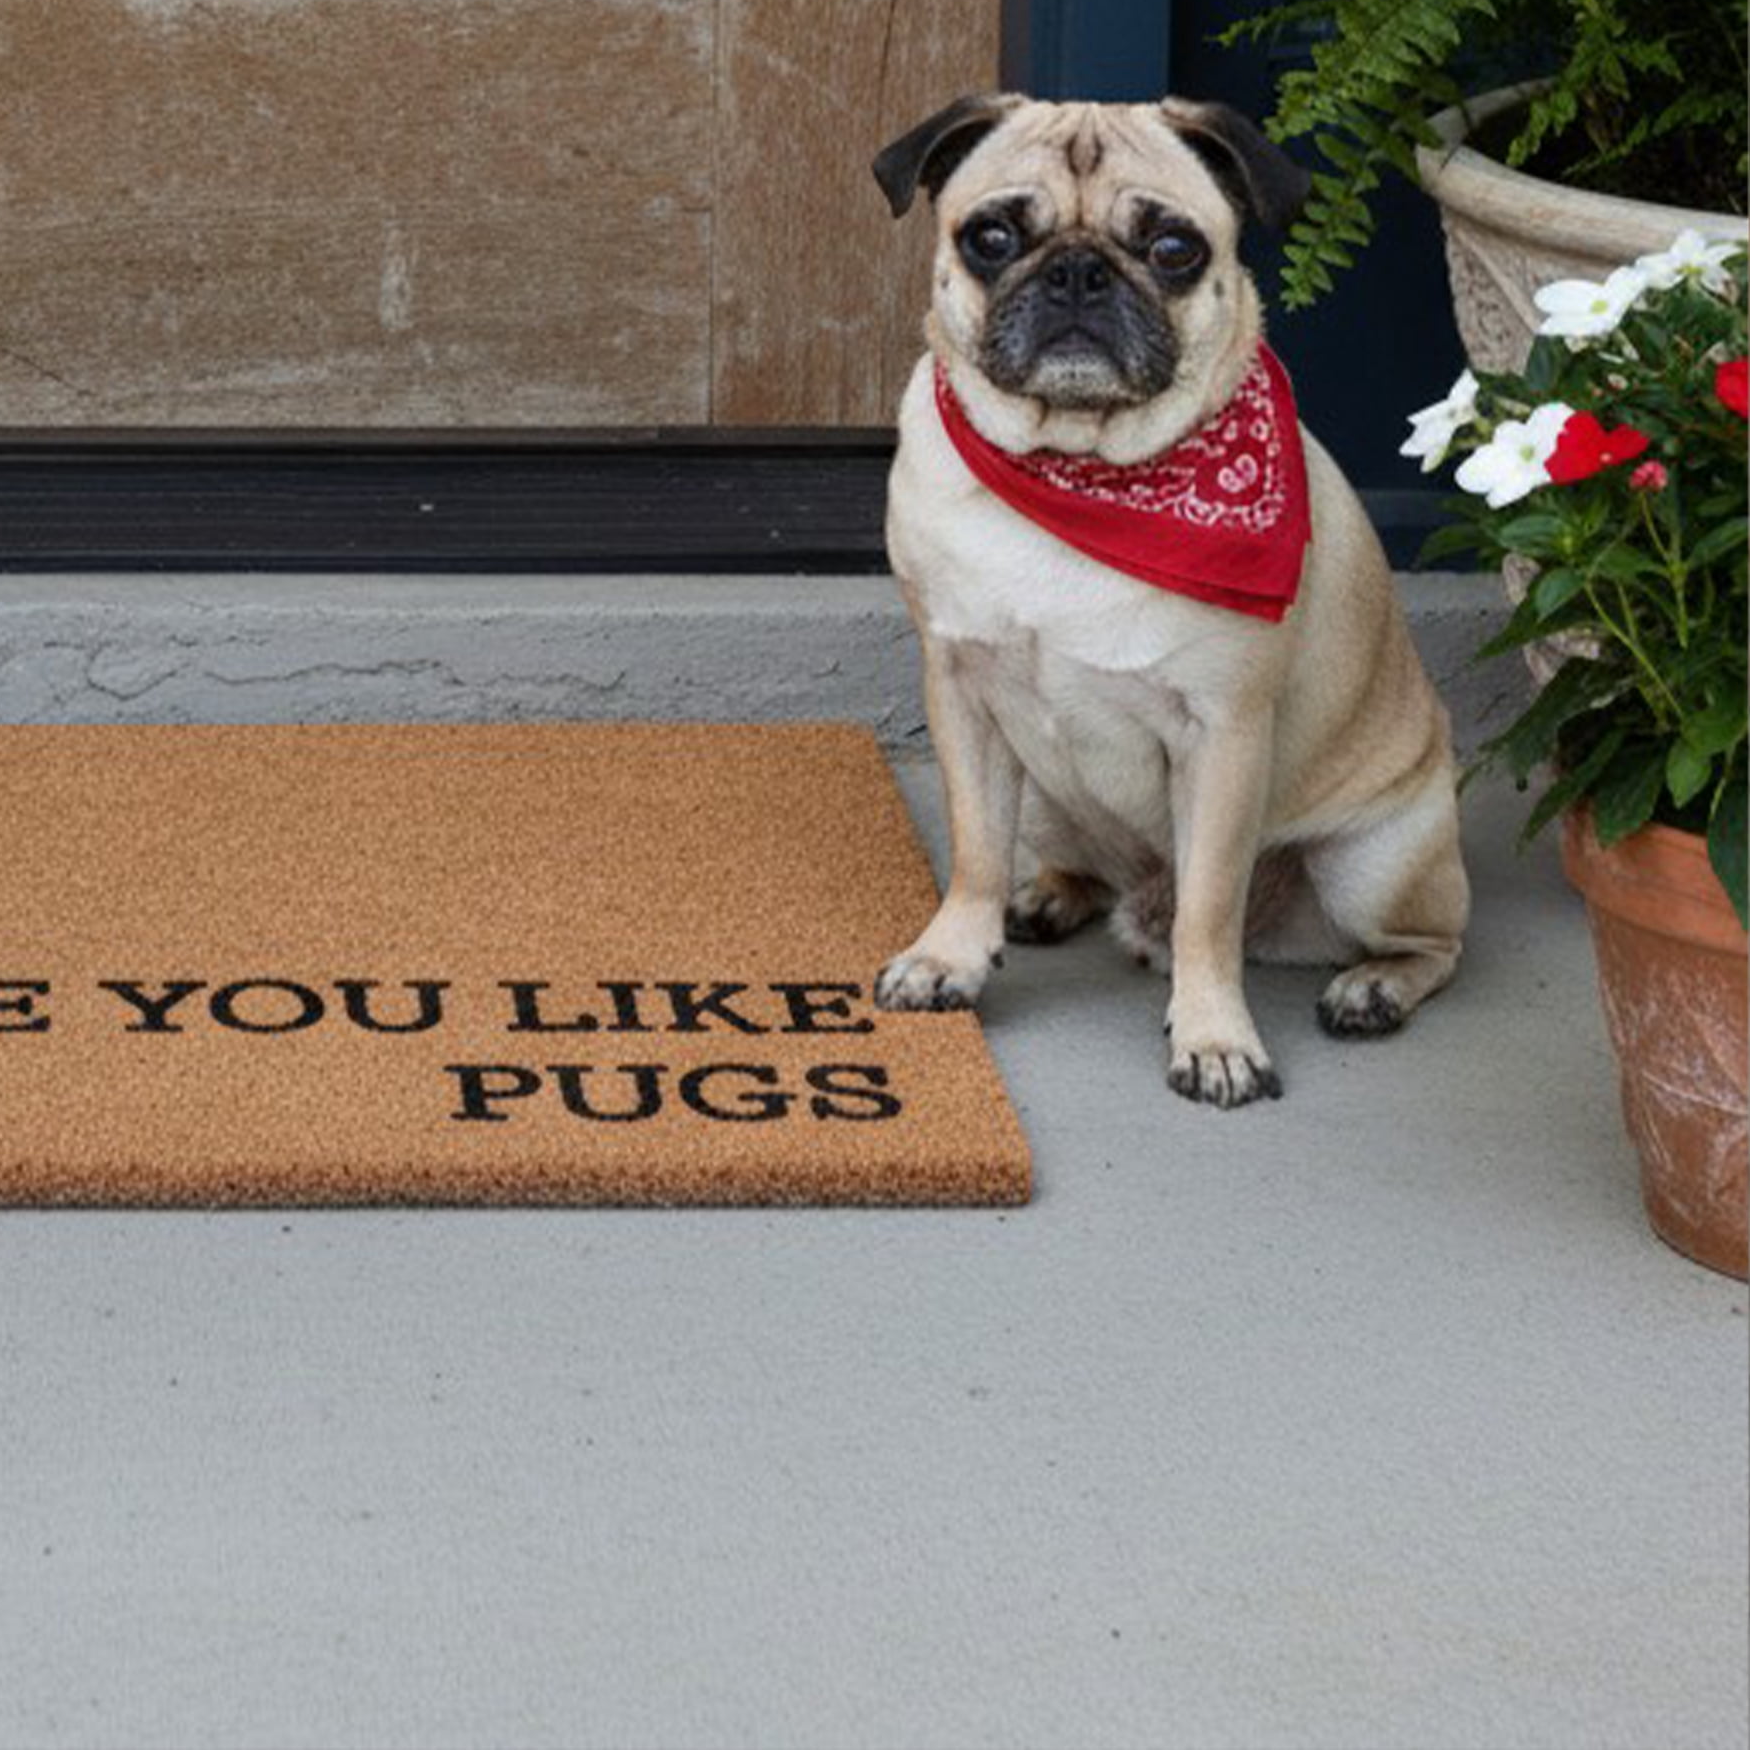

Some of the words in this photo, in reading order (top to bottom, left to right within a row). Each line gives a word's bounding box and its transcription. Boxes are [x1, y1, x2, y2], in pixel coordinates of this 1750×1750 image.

[97, 977, 452, 1036] YOU
[497, 980, 877, 1036] LIKE
[443, 1062, 903, 1123] PUGS
